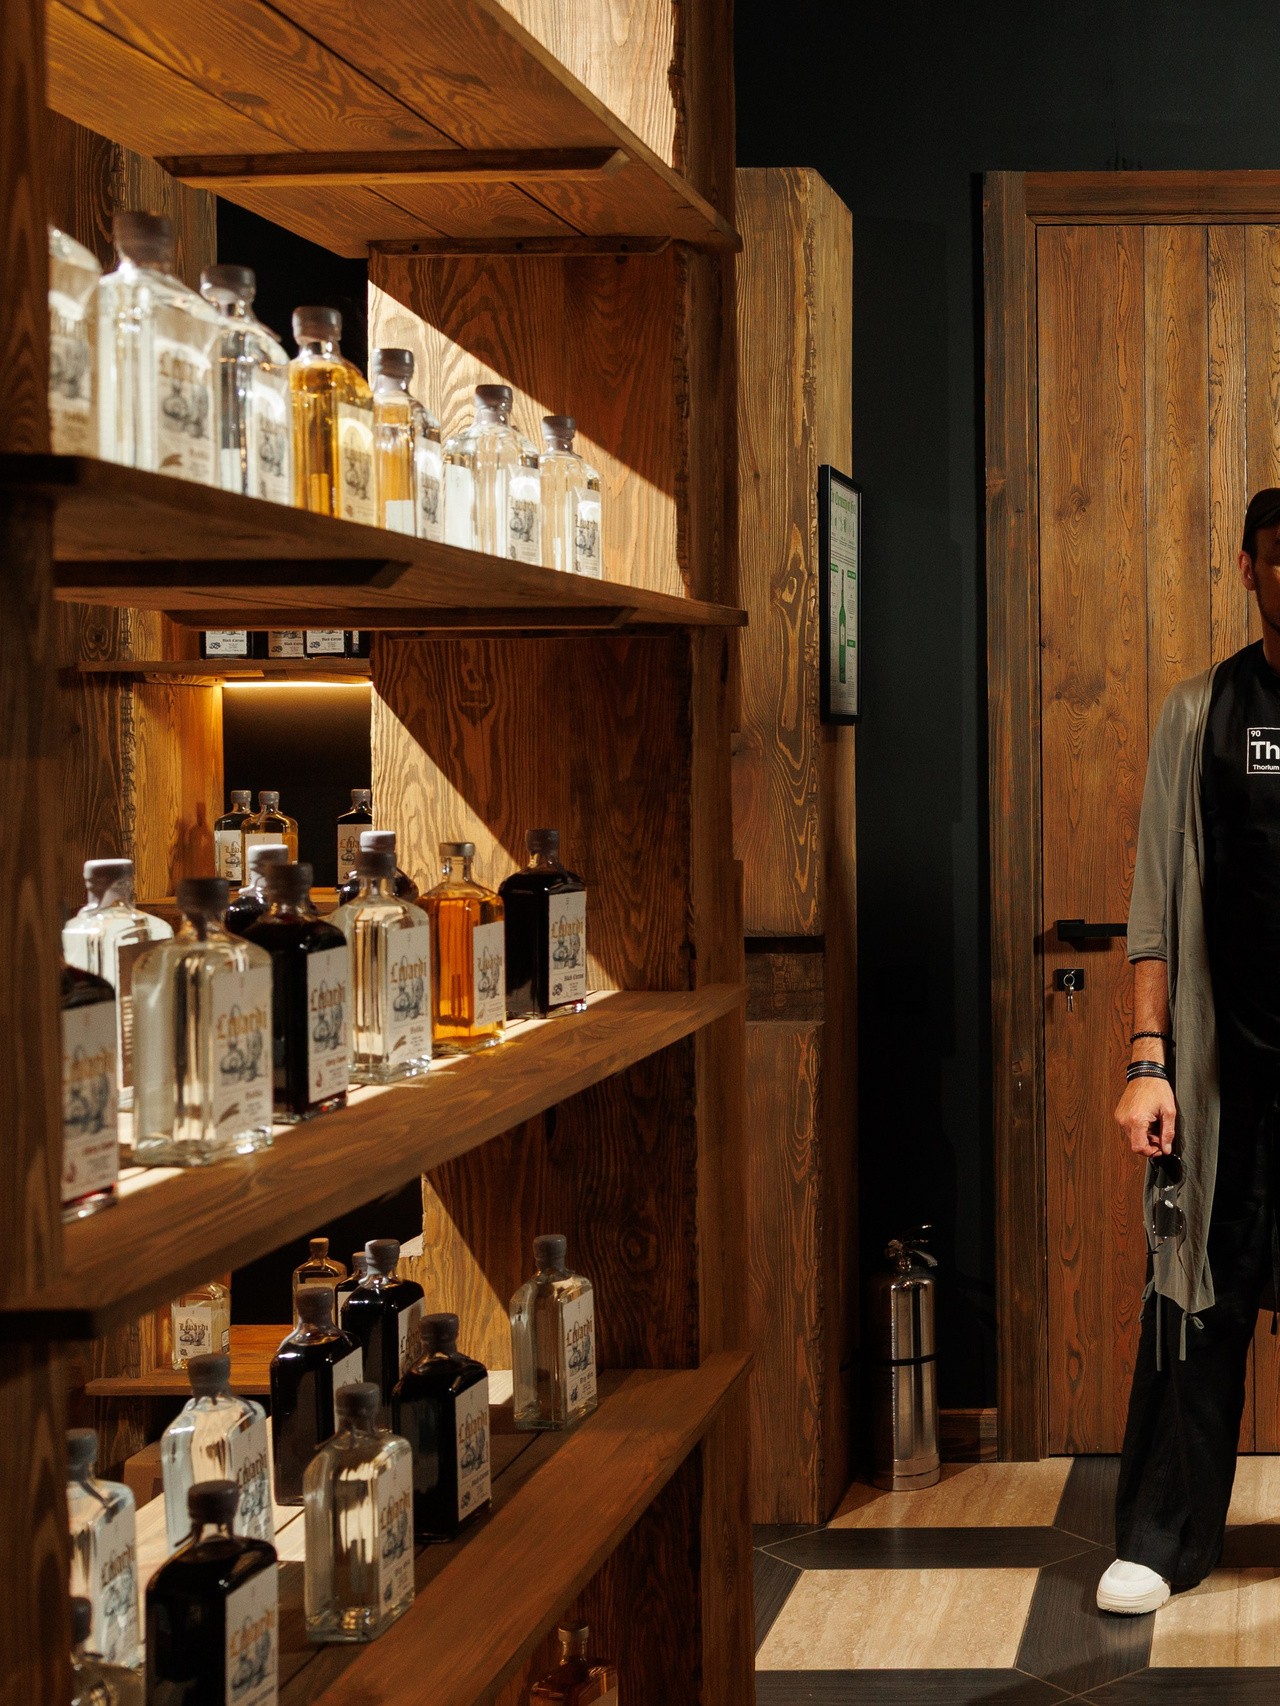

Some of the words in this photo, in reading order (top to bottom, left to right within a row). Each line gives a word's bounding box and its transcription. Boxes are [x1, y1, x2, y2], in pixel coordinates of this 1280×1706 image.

[1250, 730, 1261, 738] 90
[1250, 740, 1280, 760] Th
[1252, 763, 1280, 771] Thorium
